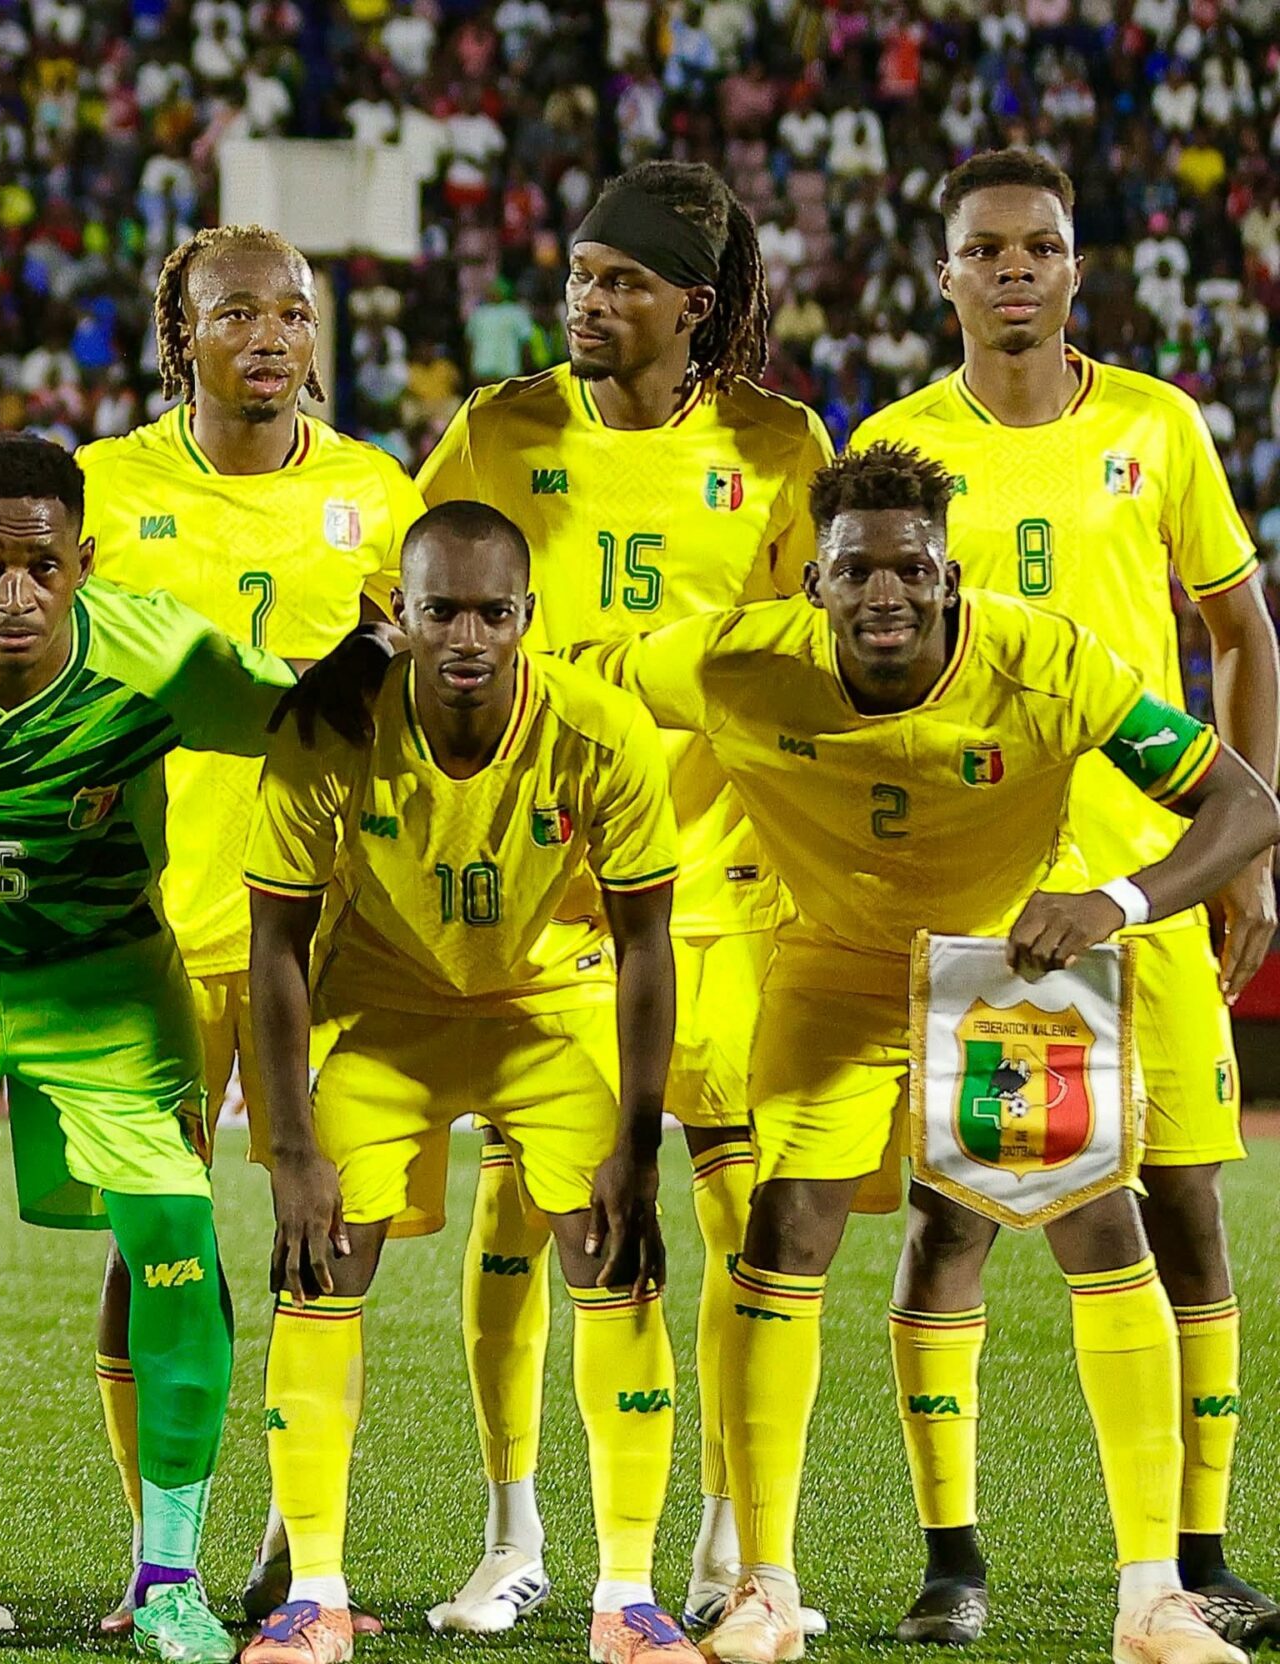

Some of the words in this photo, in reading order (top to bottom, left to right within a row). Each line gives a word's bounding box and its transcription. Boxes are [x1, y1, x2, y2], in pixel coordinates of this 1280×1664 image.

[532, 469, 569, 494] WA
[139, 515, 177, 540] WA
[1017, 518, 1054, 599] 8
[598, 531, 667, 614] 15
[239, 571, 276, 648] 7
[778, 734, 818, 760] WA
[871, 783, 910, 839] 2
[360, 811, 398, 840] WA
[435, 861, 502, 927] 10
[143, 1257, 204, 1288] WA
[480, 1252, 529, 1276] WA
[616, 1388, 672, 1413] WA
[909, 1395, 960, 1415] WA
[265, 1408, 287, 1431] A
